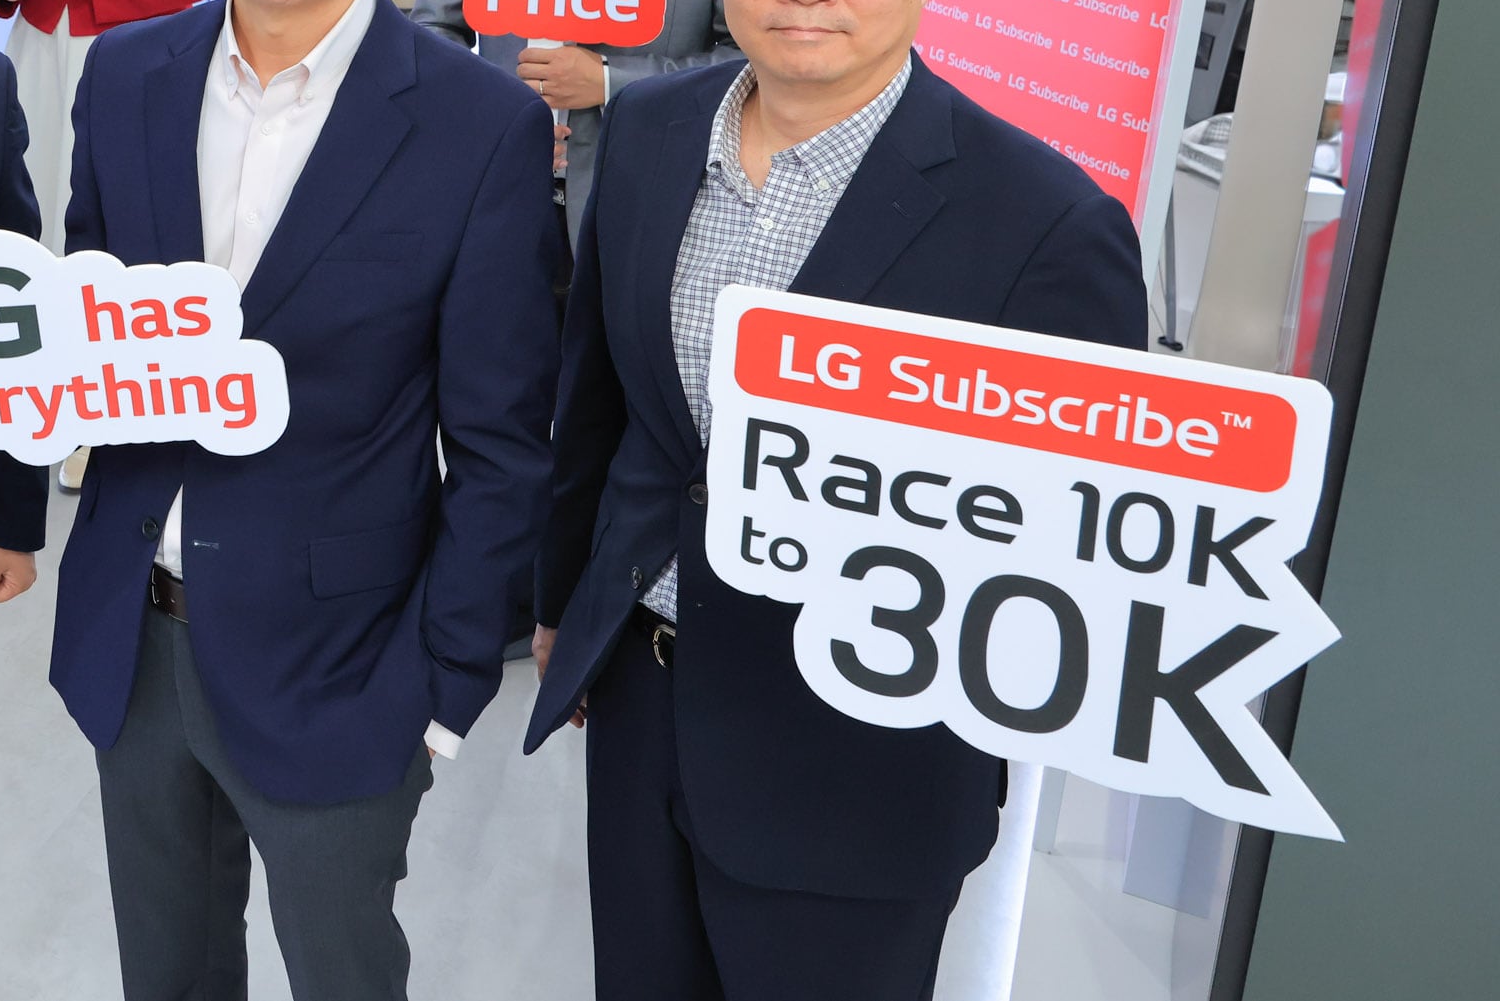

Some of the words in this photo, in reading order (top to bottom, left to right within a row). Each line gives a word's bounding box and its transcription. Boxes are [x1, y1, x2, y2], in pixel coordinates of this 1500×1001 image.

[975, 14, 991, 30] LG
[995, 20, 1052, 49] Subscribe
[1060, 40, 1078, 57] LG
[1083, 47, 1150, 79] Subscribe
[929, 46, 944, 62] LG
[948, 53, 1001, 82] Subscribe
[1008, 73, 1025, 90] LG
[1029, 81, 1089, 113] Subscribe
[1097, 104, 1116, 122] LG
[1064, 144, 1130, 180] Subscribe
[81, 284, 212, 342] has
[778, 334, 862, 391] LG
[741, 416, 1025, 545] Race
[1069, 480, 1277, 602] 10K
[739, 514, 809, 573] to
[829, 545, 1280, 798] 30K
